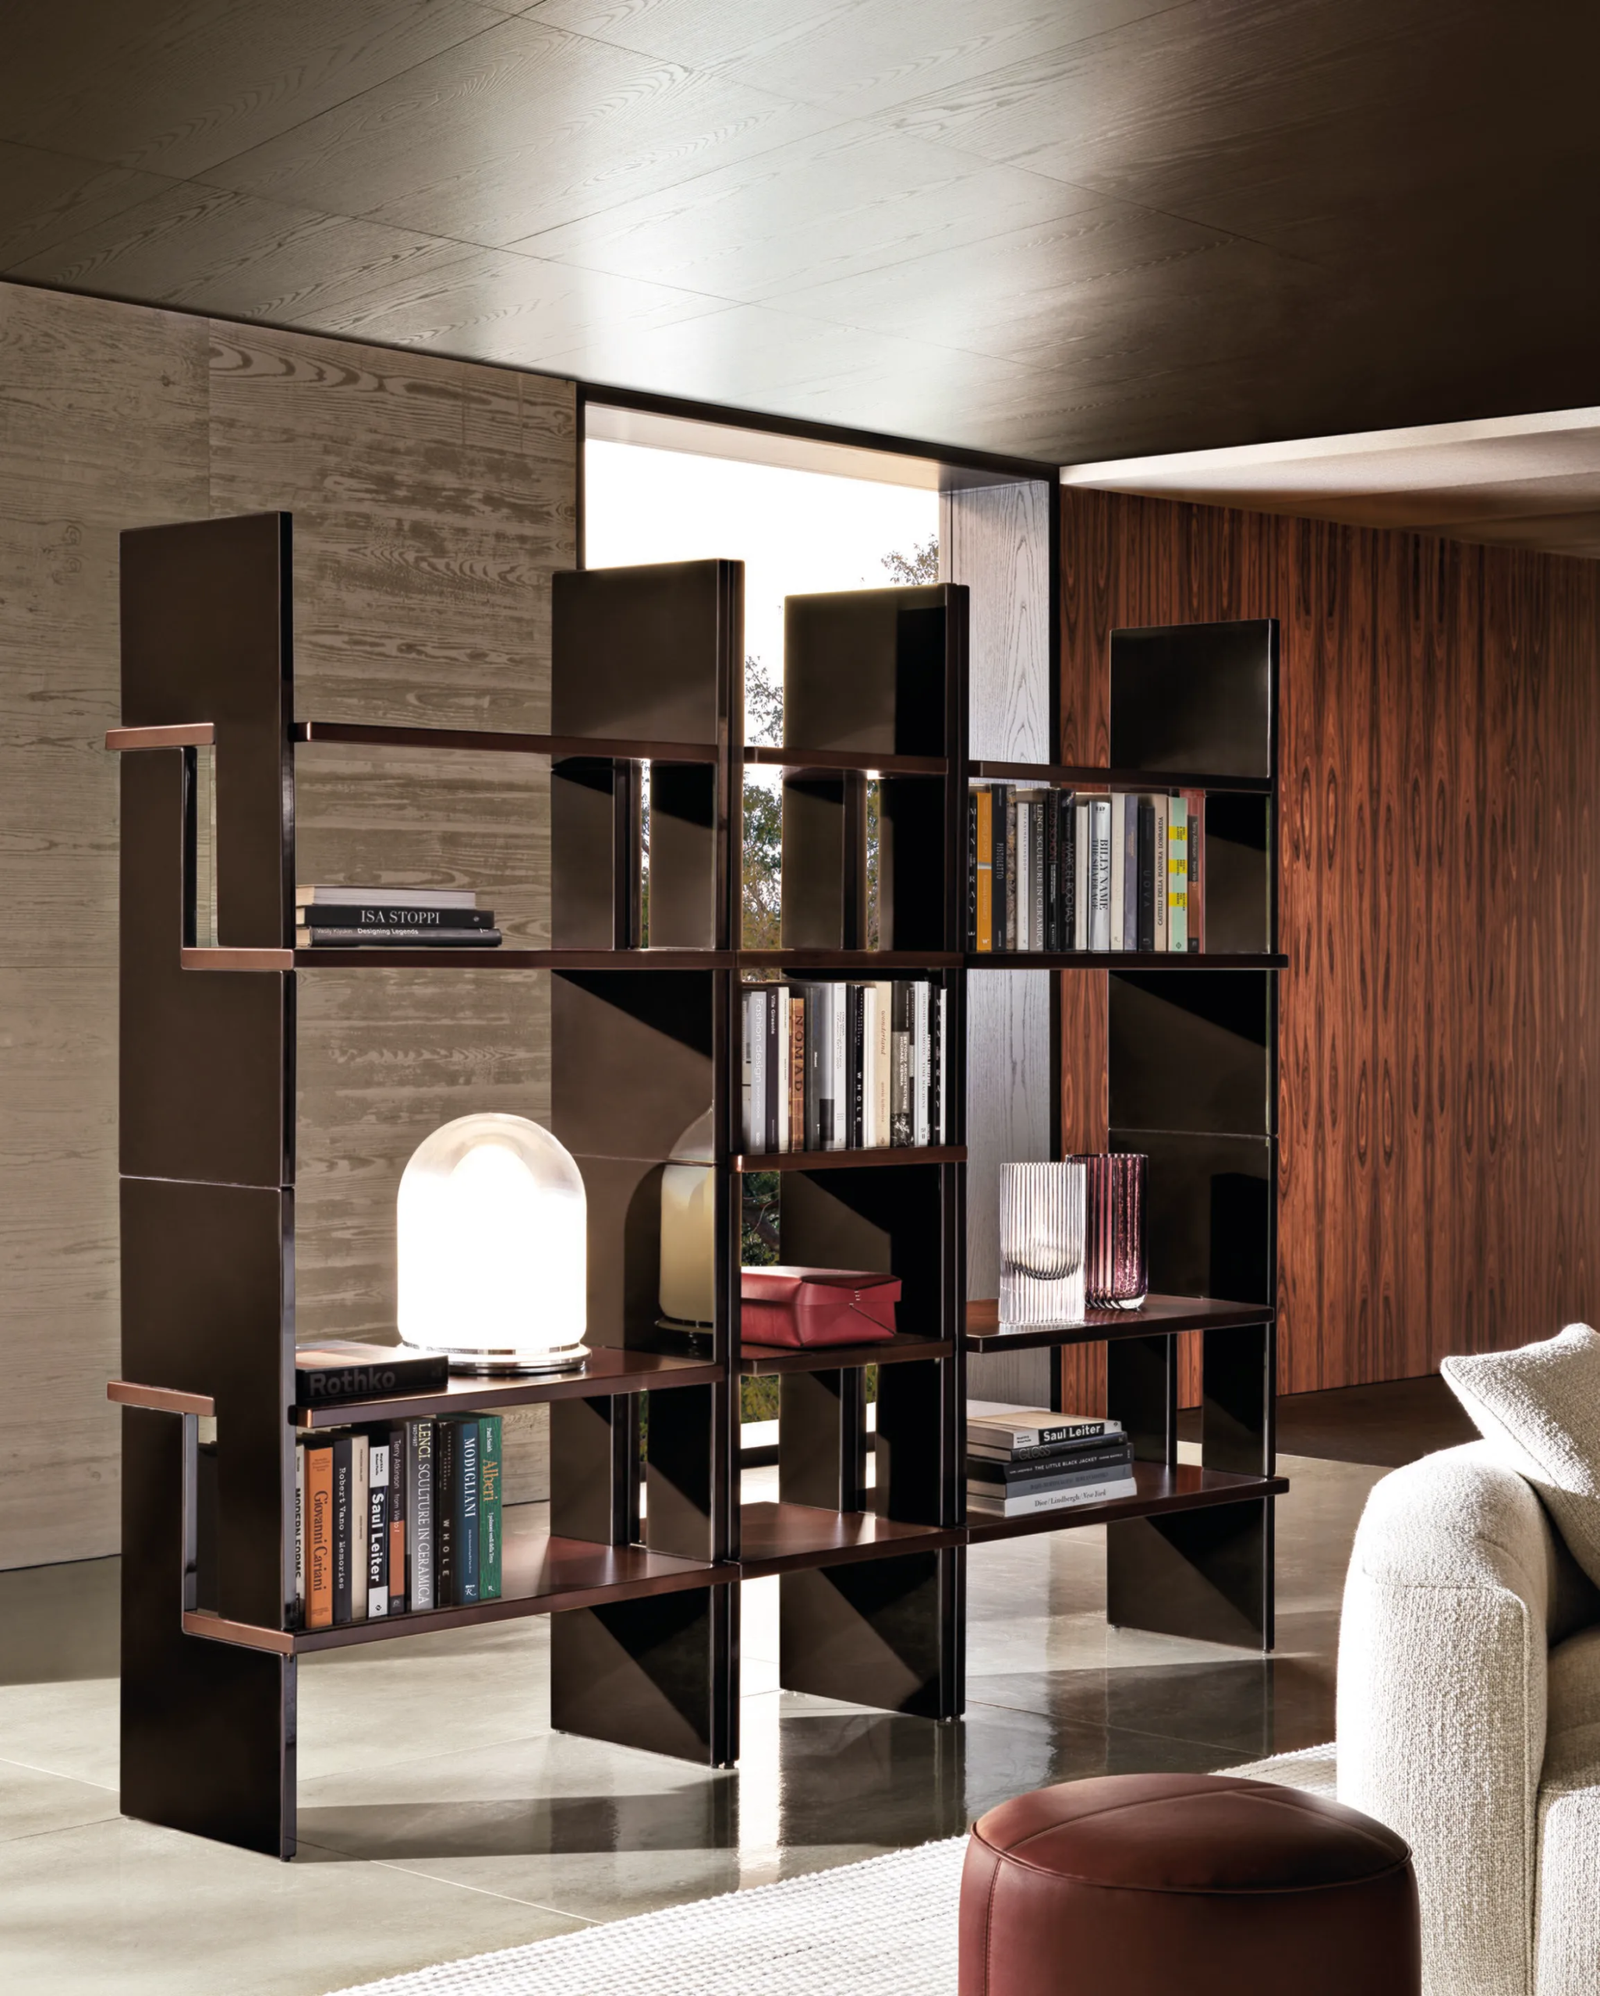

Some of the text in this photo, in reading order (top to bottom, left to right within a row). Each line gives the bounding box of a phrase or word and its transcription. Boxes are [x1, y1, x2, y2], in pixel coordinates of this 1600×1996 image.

[996, 842, 1004, 880] PISTOLETTO
[1091, 839, 1099, 911] THE SILVER AGE
[1099, 839, 1109, 911] BILLY NAME
[1036, 885, 1043, 896] IN
[357, 927, 391, 936] Designing
[391, 928, 419, 936] Legends
[360, 910, 441, 924] ISA STOPPI
[755, 998, 764, 1041] Fashion
[753, 1044, 764, 1083] design
[794, 1013, 804, 1092] NOMAD
[309, 1367, 396, 1396] Rothko
[392, 1439, 401, 1459] Terry
[1018, 1444, 1051, 1461] GLOSS
[1043, 1429, 1067, 1442] Saul
[1069, 1425, 1101, 1438] Leiter
[393, 1459, 401, 1489] Atkinson
[464, 1437, 477, 1518] MODIGLIANI
[481, 1458, 499, 1502] Alberi
[1045, 1462, 1062, 1470] LITTLE
[1062, 1459, 1078, 1468] BLACK
[1078, 1456, 1098, 1465] JACKET
[313, 1490, 329, 1545] Giovanni
[393, 1493, 401, 1514] from
[417, 1422, 432, 1605] LENCI. SCULTURE IN CERAMICA
[338, 1467, 347, 1589] Robert Vano Memories
[370, 1492, 385, 1582] Saul Leiter
[441, 1518, 450, 1577] WHOLE
[313, 1546, 328, 1591] Cariani
